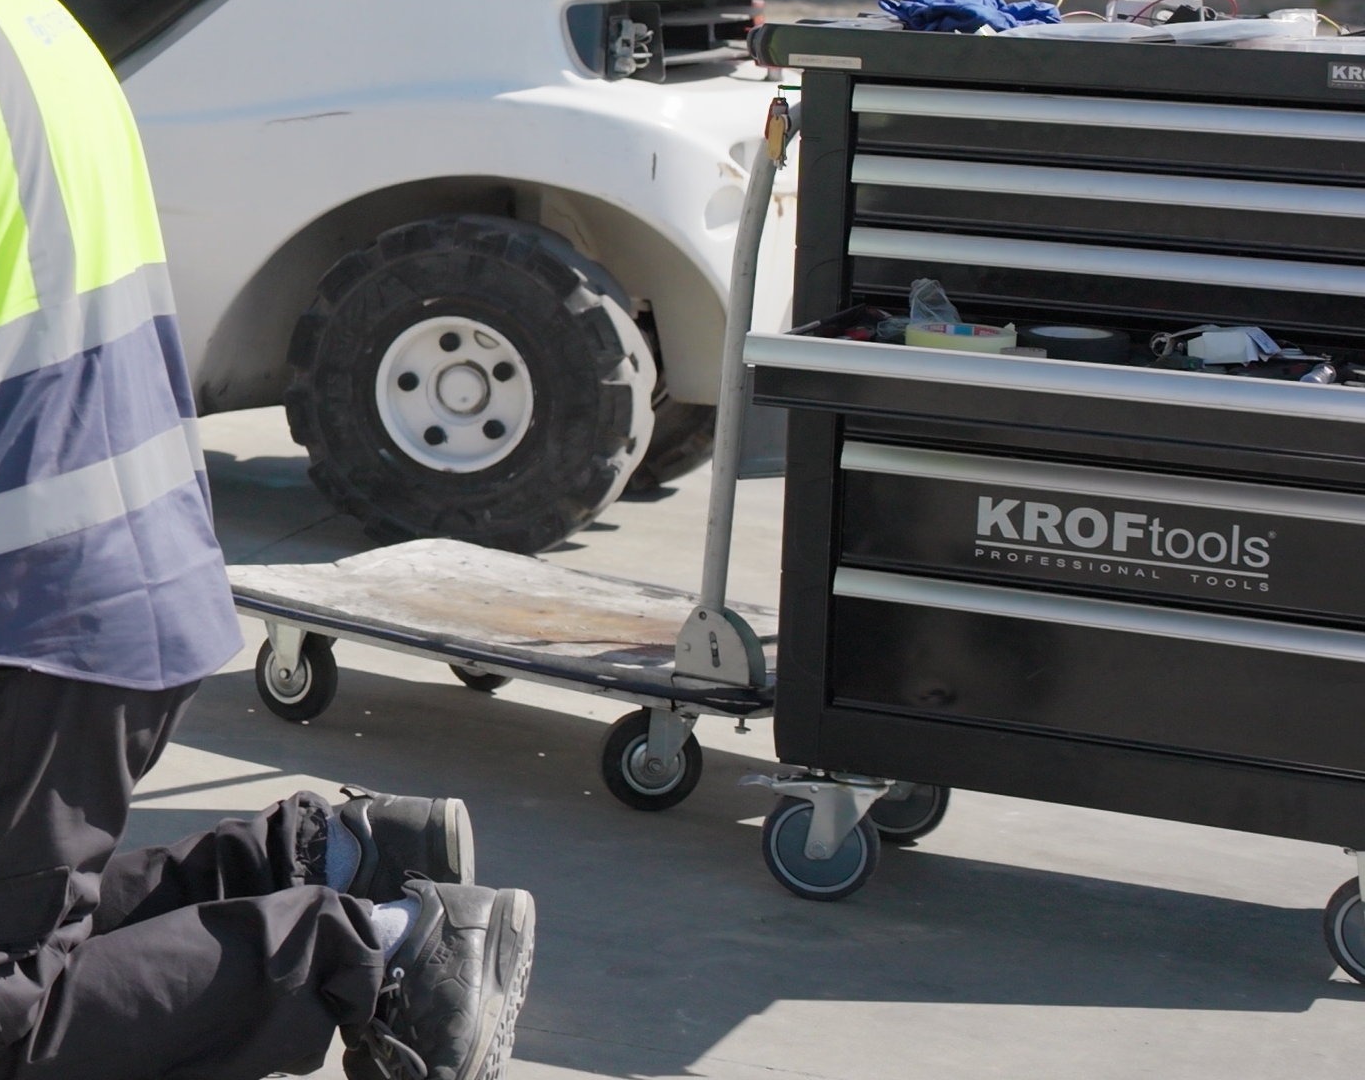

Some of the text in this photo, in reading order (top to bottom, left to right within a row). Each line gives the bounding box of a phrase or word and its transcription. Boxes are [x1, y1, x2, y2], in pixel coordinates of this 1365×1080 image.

[1332, 65, 1365, 81] KR
[975, 548, 1269, 592] PROFESSIONAL TOOLS
